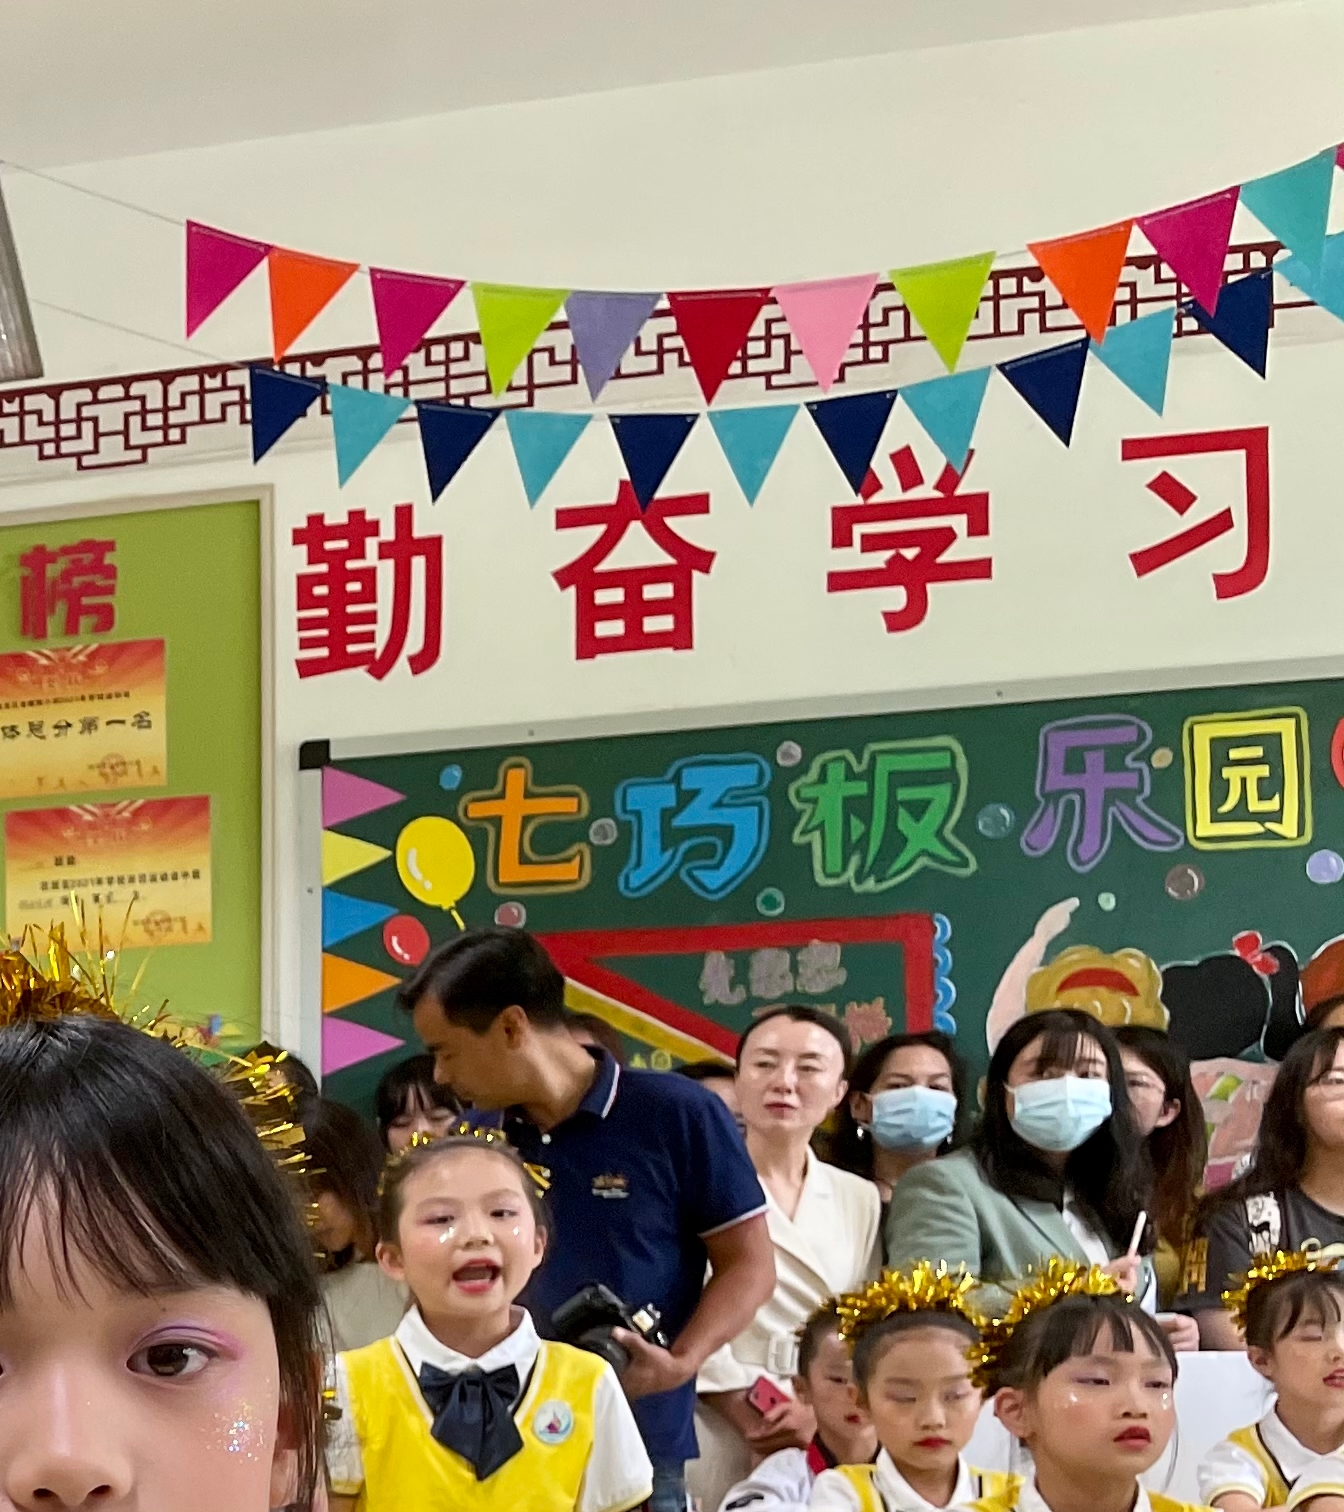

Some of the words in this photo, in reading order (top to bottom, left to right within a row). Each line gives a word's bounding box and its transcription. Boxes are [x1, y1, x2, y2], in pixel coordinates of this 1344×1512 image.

[291, 425, 1271, 681] 勤奋学习
[459, 705, 1313, 898] 七巧板乐园
